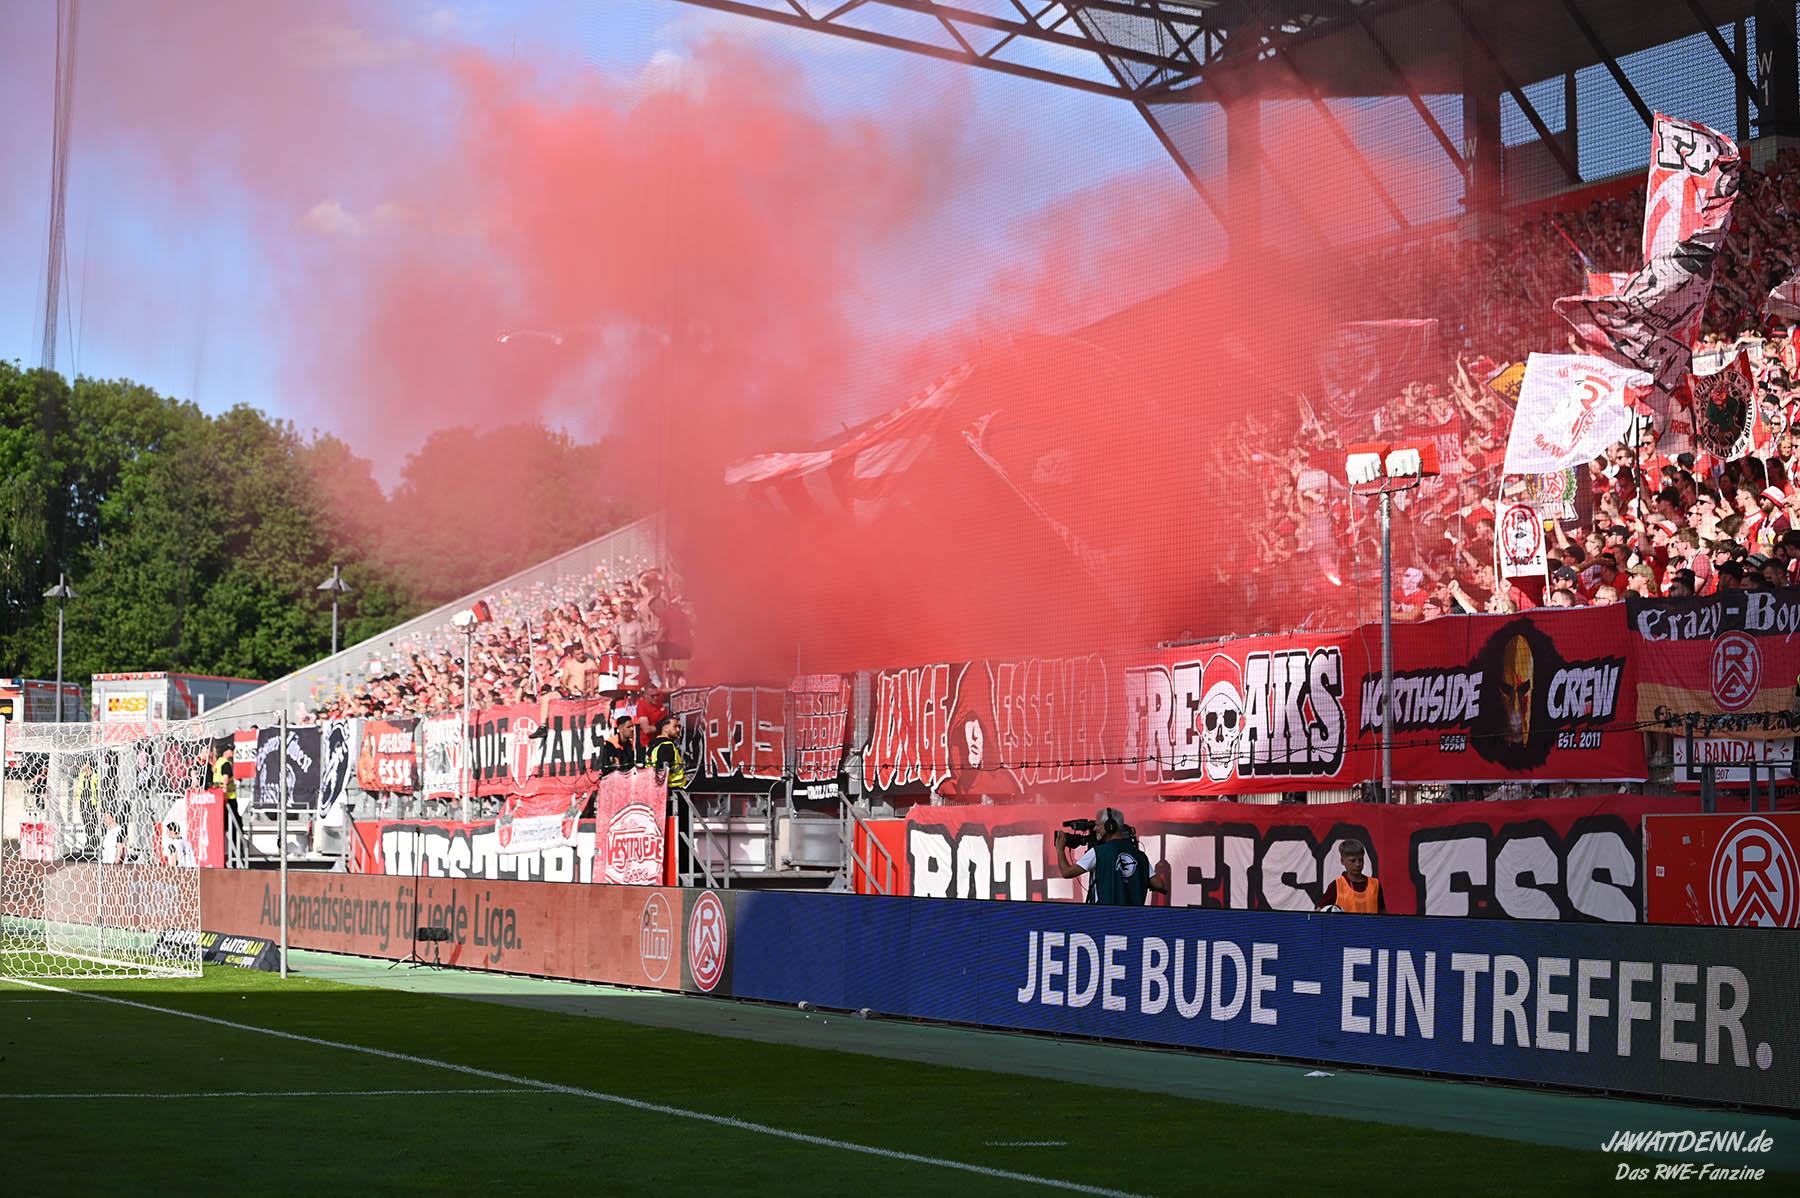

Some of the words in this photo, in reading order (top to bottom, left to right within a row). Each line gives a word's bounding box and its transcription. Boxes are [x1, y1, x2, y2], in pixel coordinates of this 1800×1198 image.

[1757, 50, 1773, 76] W
[863, 665, 951, 792] JUNGE
[1360, 671, 1483, 731] NORTHSIDE
[1548, 664, 1618, 720] CREW
[1558, 732, 1576, 748] EST.
[1579, 731, 1601, 748] 2011
[1704, 740, 1756, 763] BANDA
[260, 883, 391, 951] Automatisierung
[396, 886, 422, 939] für
[474, 891, 522, 964] Liga.
[1018, 931, 1127, 1012] JEDE
[1140, 936, 1279, 1026] BUDE
[1341, 946, 1436, 1040] EIN
[1451, 953, 1773, 1071] TREFFER.
